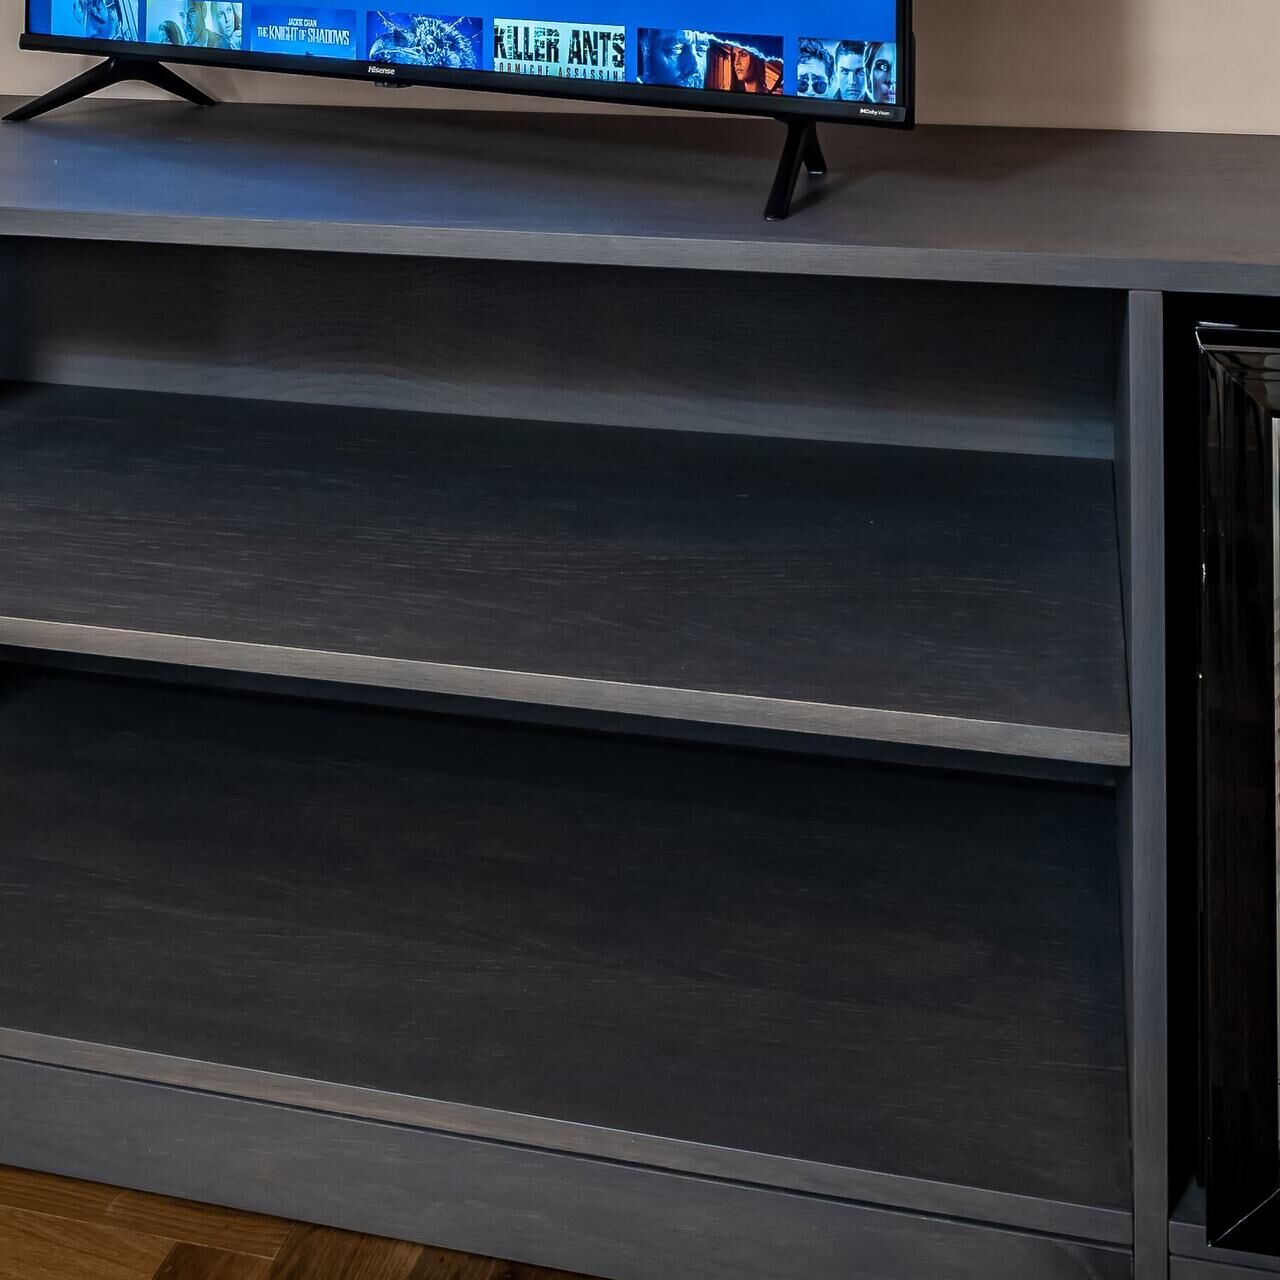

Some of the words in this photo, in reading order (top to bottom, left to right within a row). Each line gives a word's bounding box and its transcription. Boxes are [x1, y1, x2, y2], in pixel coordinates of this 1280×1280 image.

[257, 26, 268, 38] THE
[269, 25, 298, 41] KNIGHT
[299, 29, 307, 40] OF
[307, 28, 350, 46] SHADOWS
[494, 25, 560, 63] KILLER
[567, 29, 625, 68] ANTS
[368, 66, 395, 75] Hisense
